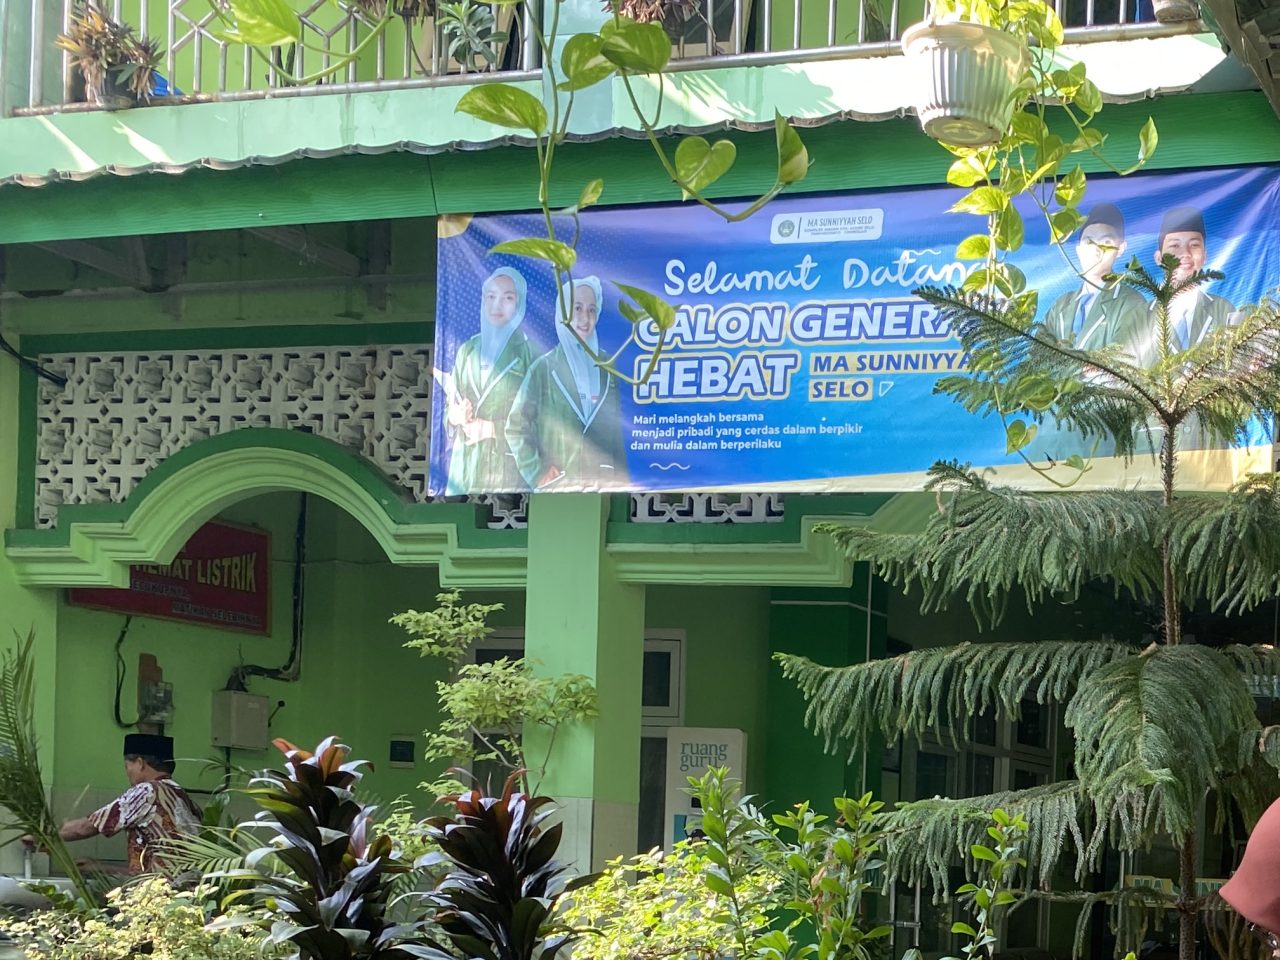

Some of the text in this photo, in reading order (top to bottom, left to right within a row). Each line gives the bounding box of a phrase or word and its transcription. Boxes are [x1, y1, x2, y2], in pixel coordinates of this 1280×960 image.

[807, 218, 818, 227] MA
[857, 215, 873, 225] SELO
[664, 251, 986, 295] Selamat Datan
[638, 303, 964, 343] CALON GENER
[638, 352, 973, 397] HEBAT MA SUNNIYYA
[812, 380, 869, 398] SELO
[633, 412, 764, 426] Mari melangkah bersama
[632, 423, 864, 439] menjadi pribadi yang cerdas dalam berpikir
[630, 439, 782, 452] dan mulia dalam berperilaku
[196, 551, 257, 593] LISTRIK
[680, 742, 728, 761] ruang
[679, 754, 721, 772] guru
